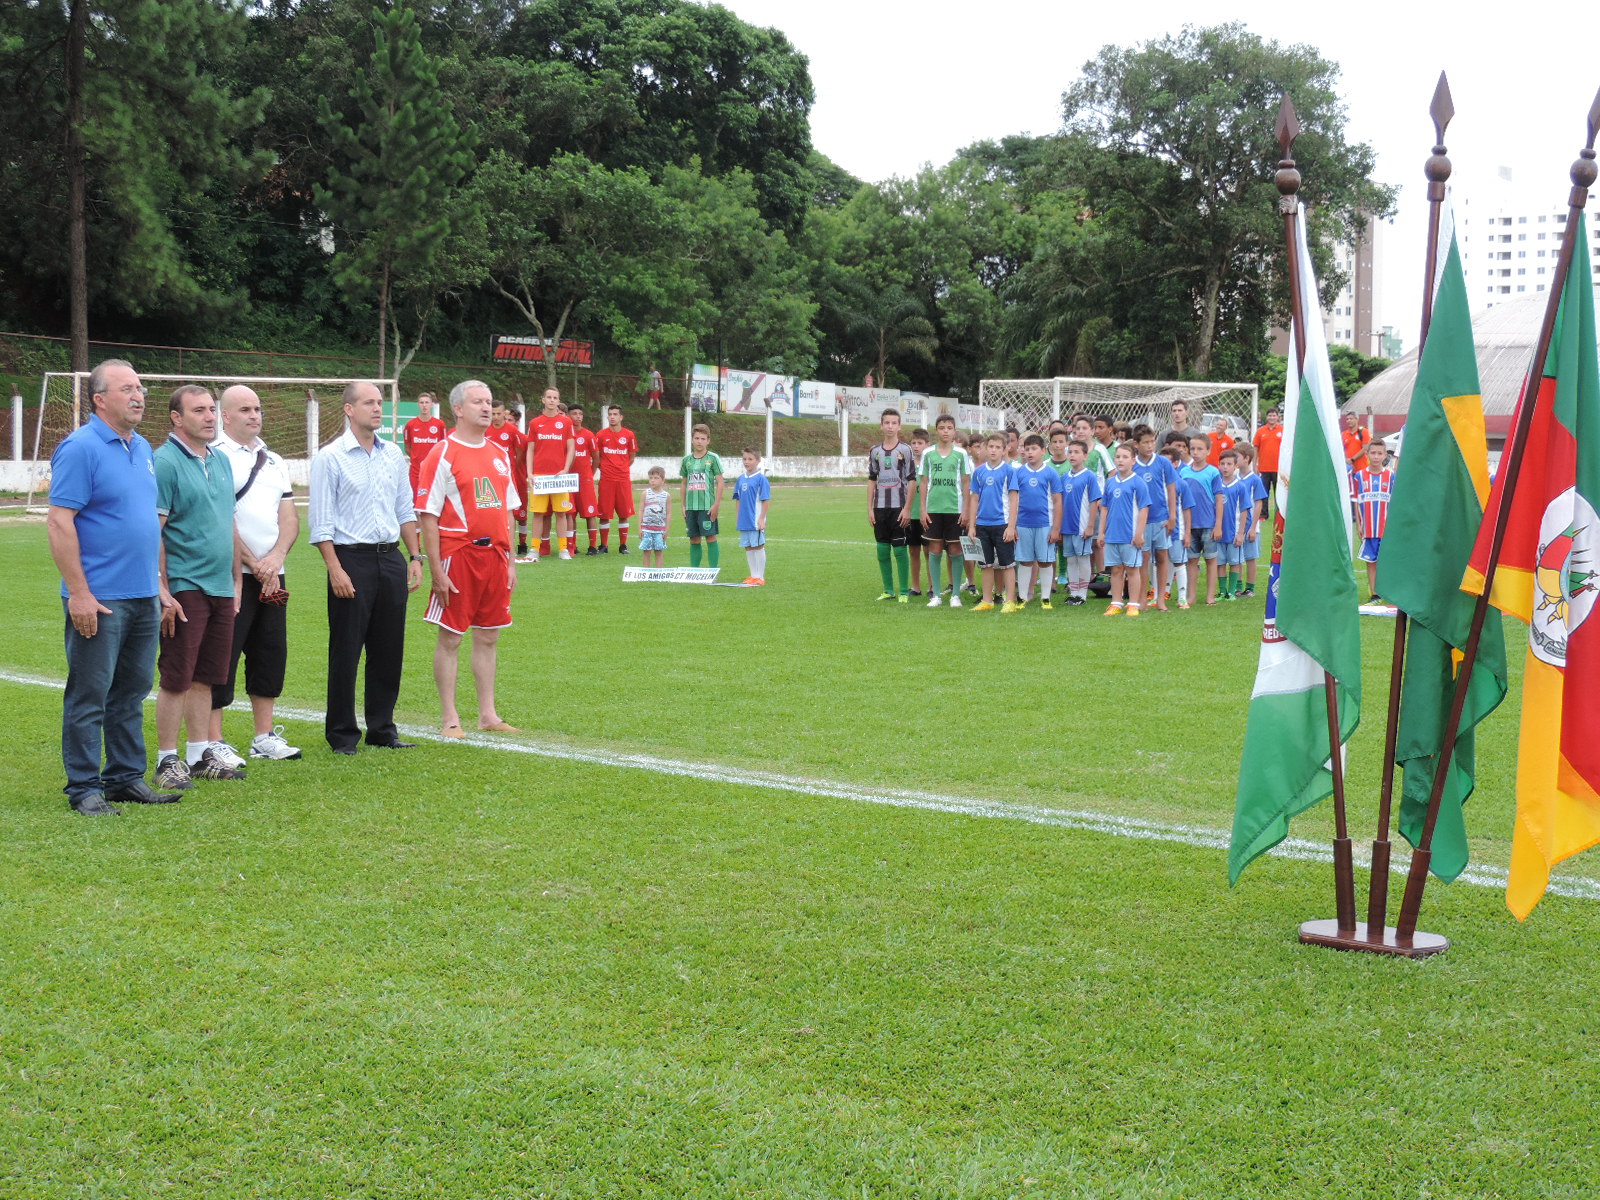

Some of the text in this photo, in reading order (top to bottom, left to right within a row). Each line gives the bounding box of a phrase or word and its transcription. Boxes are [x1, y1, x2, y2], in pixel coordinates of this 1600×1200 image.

[603, 447, 627, 455] Banrisul
[534, 479, 577, 490] SC INTERNACIONAL
[648, 572, 675, 580] AMIGOS
